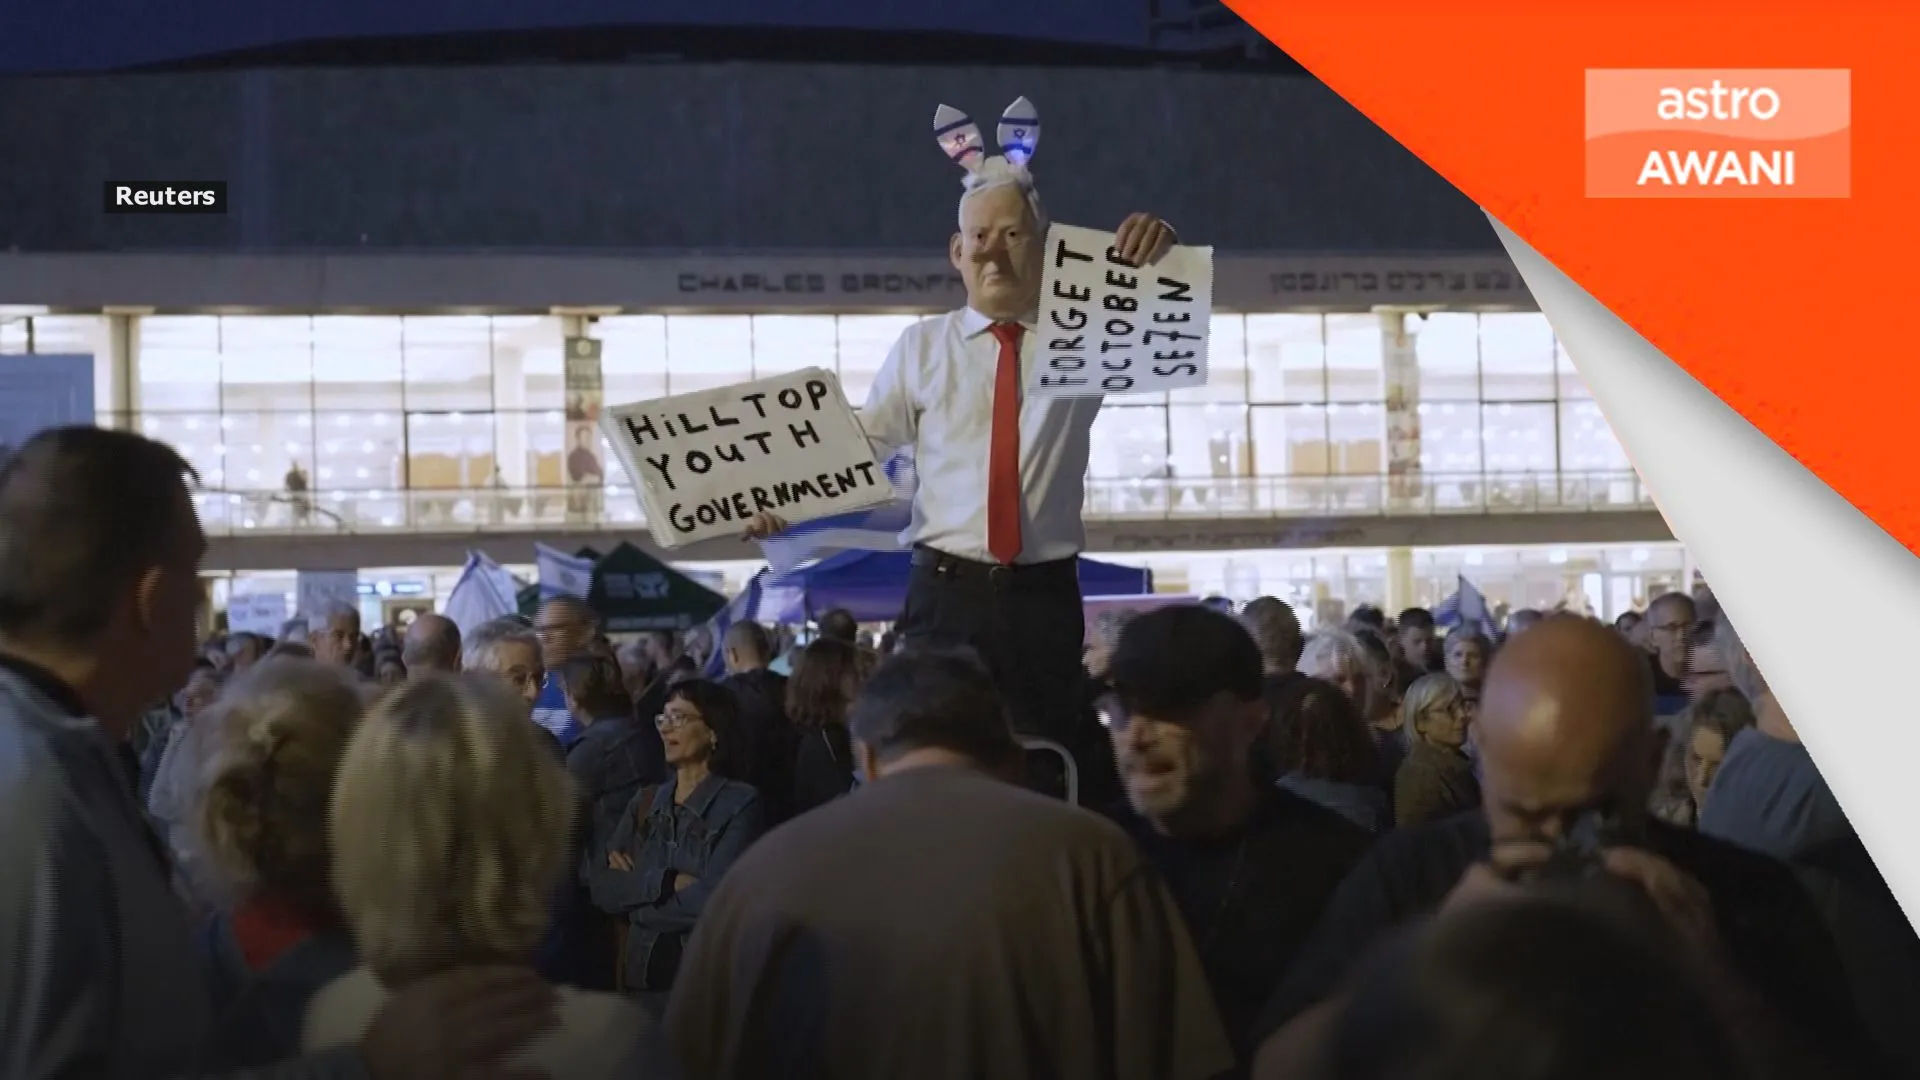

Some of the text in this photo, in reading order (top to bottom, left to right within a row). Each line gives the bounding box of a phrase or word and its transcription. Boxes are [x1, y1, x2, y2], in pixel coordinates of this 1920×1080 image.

[678, 273, 825, 293] CHARLES
[1040, 239, 1094, 388] FORGET
[669, 461, 874, 533] GOVERNMENT
